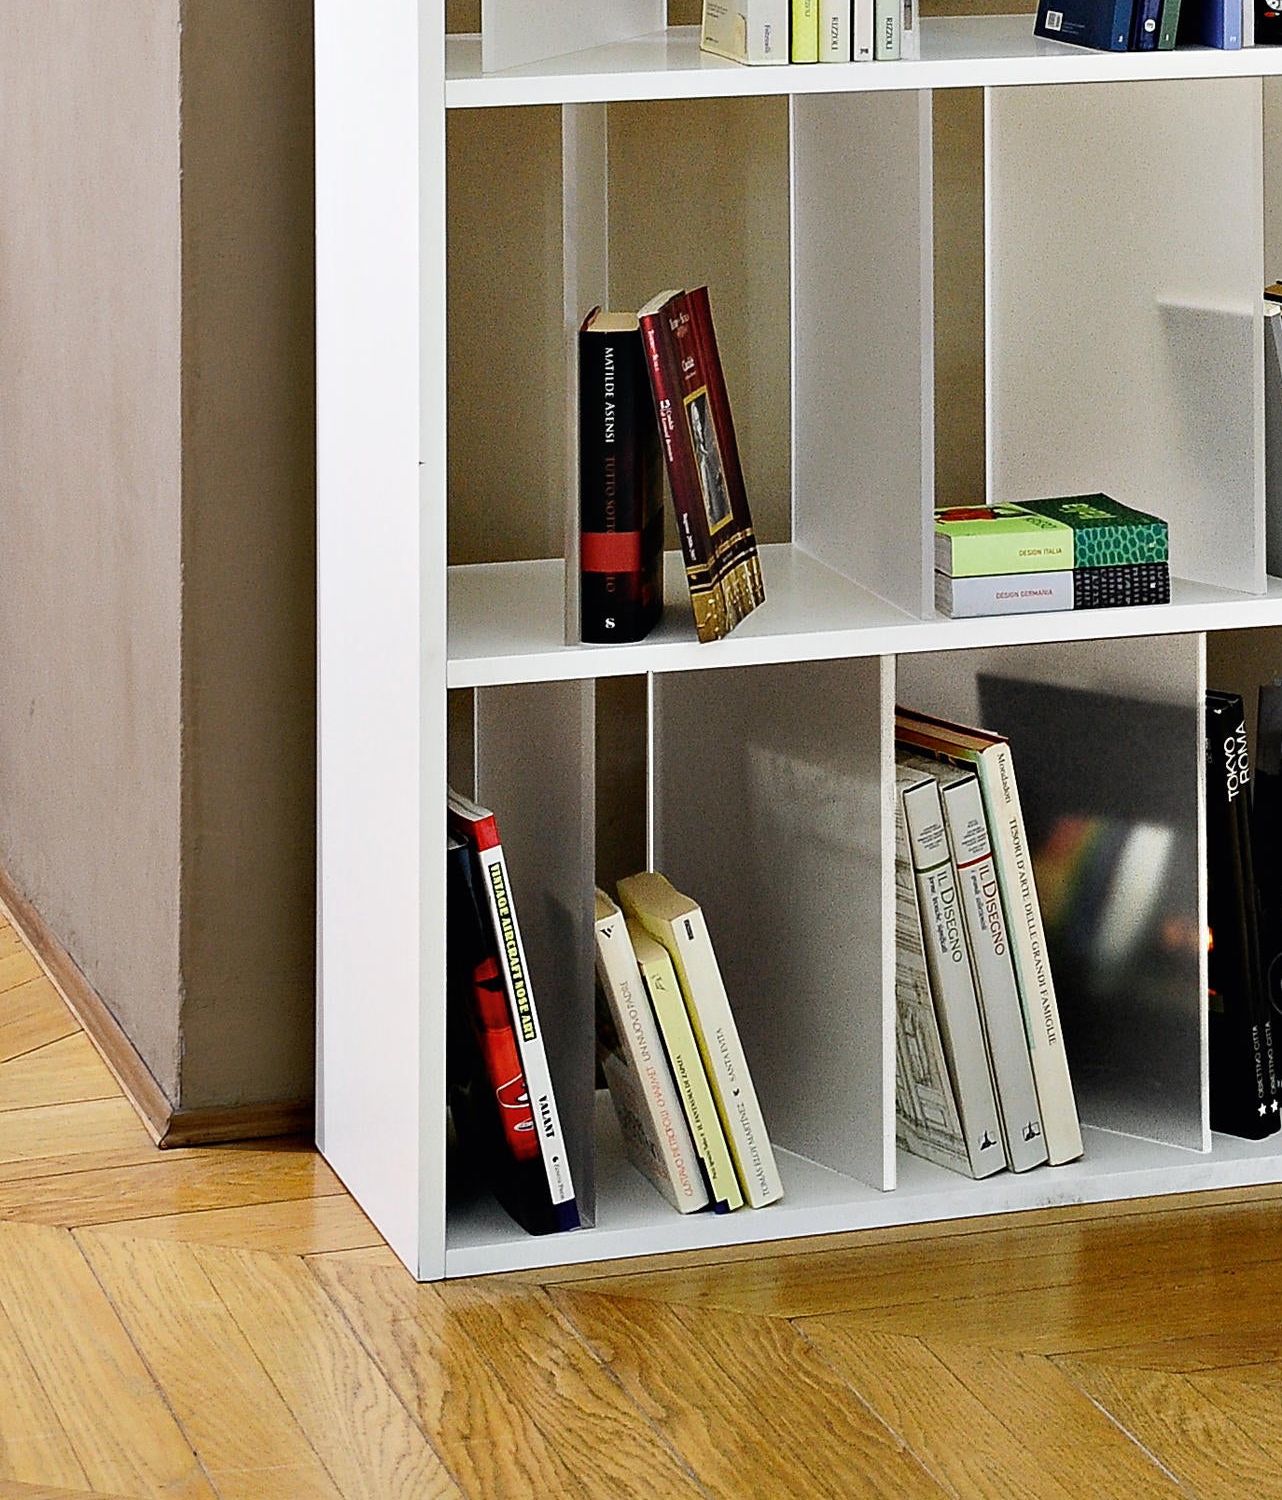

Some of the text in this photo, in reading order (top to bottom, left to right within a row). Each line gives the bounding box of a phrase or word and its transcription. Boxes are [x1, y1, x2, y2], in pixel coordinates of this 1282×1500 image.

[830, 16, 838, 50] RIZZOLI
[885, 17, 893, 50] RIZZOLI
[604, 347, 615, 442] MATILDE ASENSI
[605, 455, 615, 495] TUTTO
[1018, 545, 1062, 557] DESIGN ITALIA
[995, 587, 1053, 600] DESIGN GERMANIA
[1224, 737, 1240, 802] TOKYO
[1236, 720, 1250, 784] ROMA
[935, 870, 964, 964] IL DISEGNO
[976, 864, 1006, 958] IL DISEGNO
[995, 752, 1058, 1045] Mondadori TESORI D'ARTE DELLE GRANDI FAMIGLIE
[487, 863, 536, 1039] VINTAGE AIRCRAFT NOSE ART
[639, 1046, 652, 1061] UN
[714, 1027, 728, 1052] EVITA
[721, 1052, 737, 1082] SANTA
[537, 1095, 555, 1138] VALANT
[673, 1157, 694, 1197] GUSTAVO
